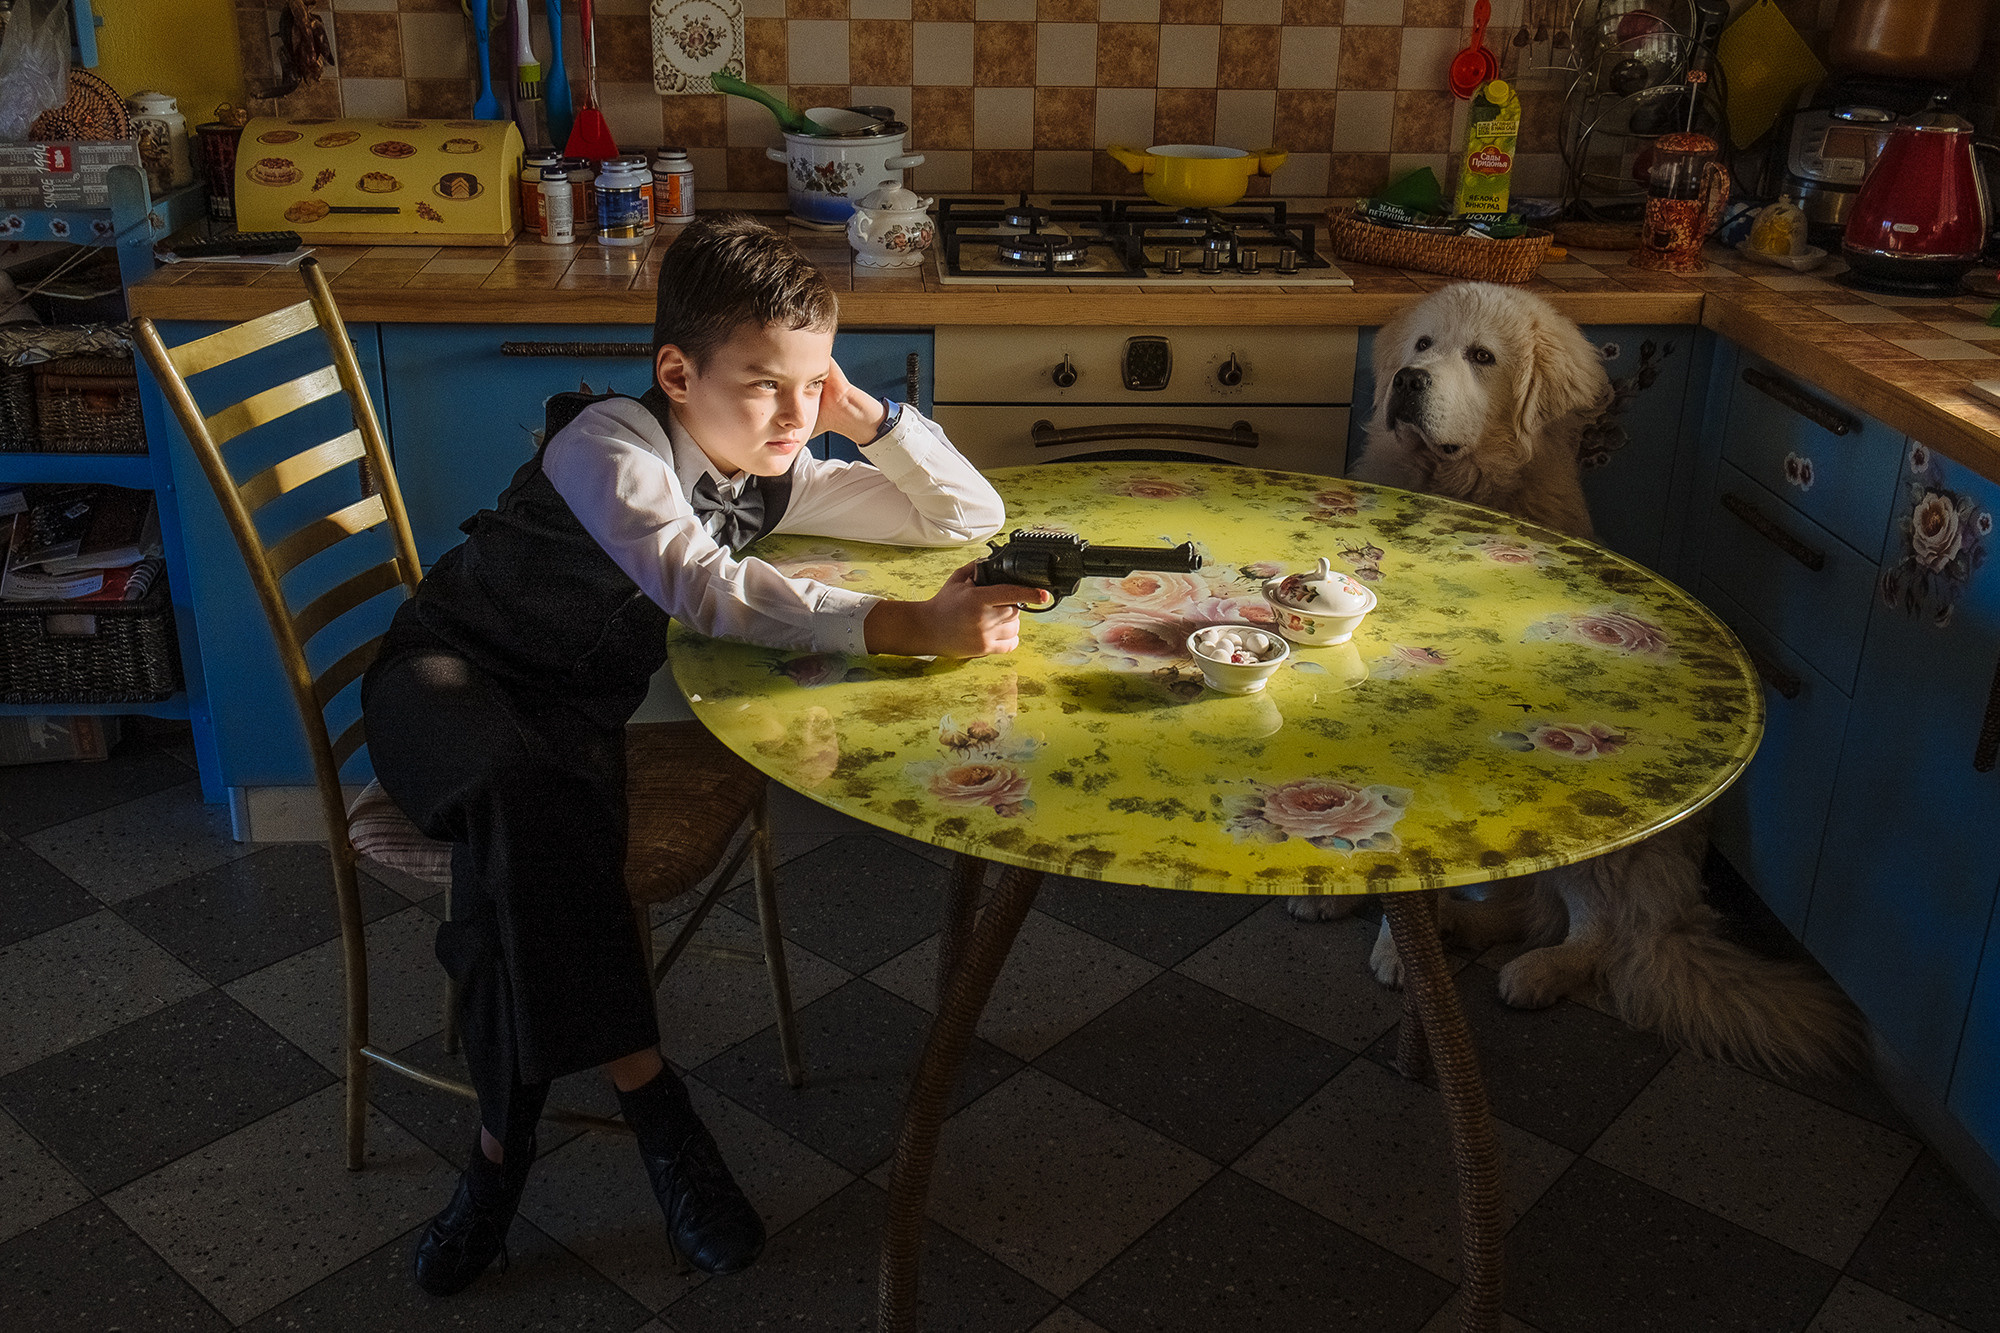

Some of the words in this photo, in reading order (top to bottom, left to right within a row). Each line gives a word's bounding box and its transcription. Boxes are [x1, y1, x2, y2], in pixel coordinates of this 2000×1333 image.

[33, 144, 52, 174] 1994
[1471, 157, 1508, 169] Придонья
[1480, 152, 1501, 162] Сады
[40, 178, 57, 209] SINCE
[1469, 195, 1500, 203] ЯБЛОКО
[1378, 203, 1405, 215] ЗЕЛЕНЬ
[1465, 202, 1500, 211] ВИНОГРАД
[1368, 209, 1412, 223] ПЕТРУШКИ
[1465, 213, 1503, 223] УКРОП
